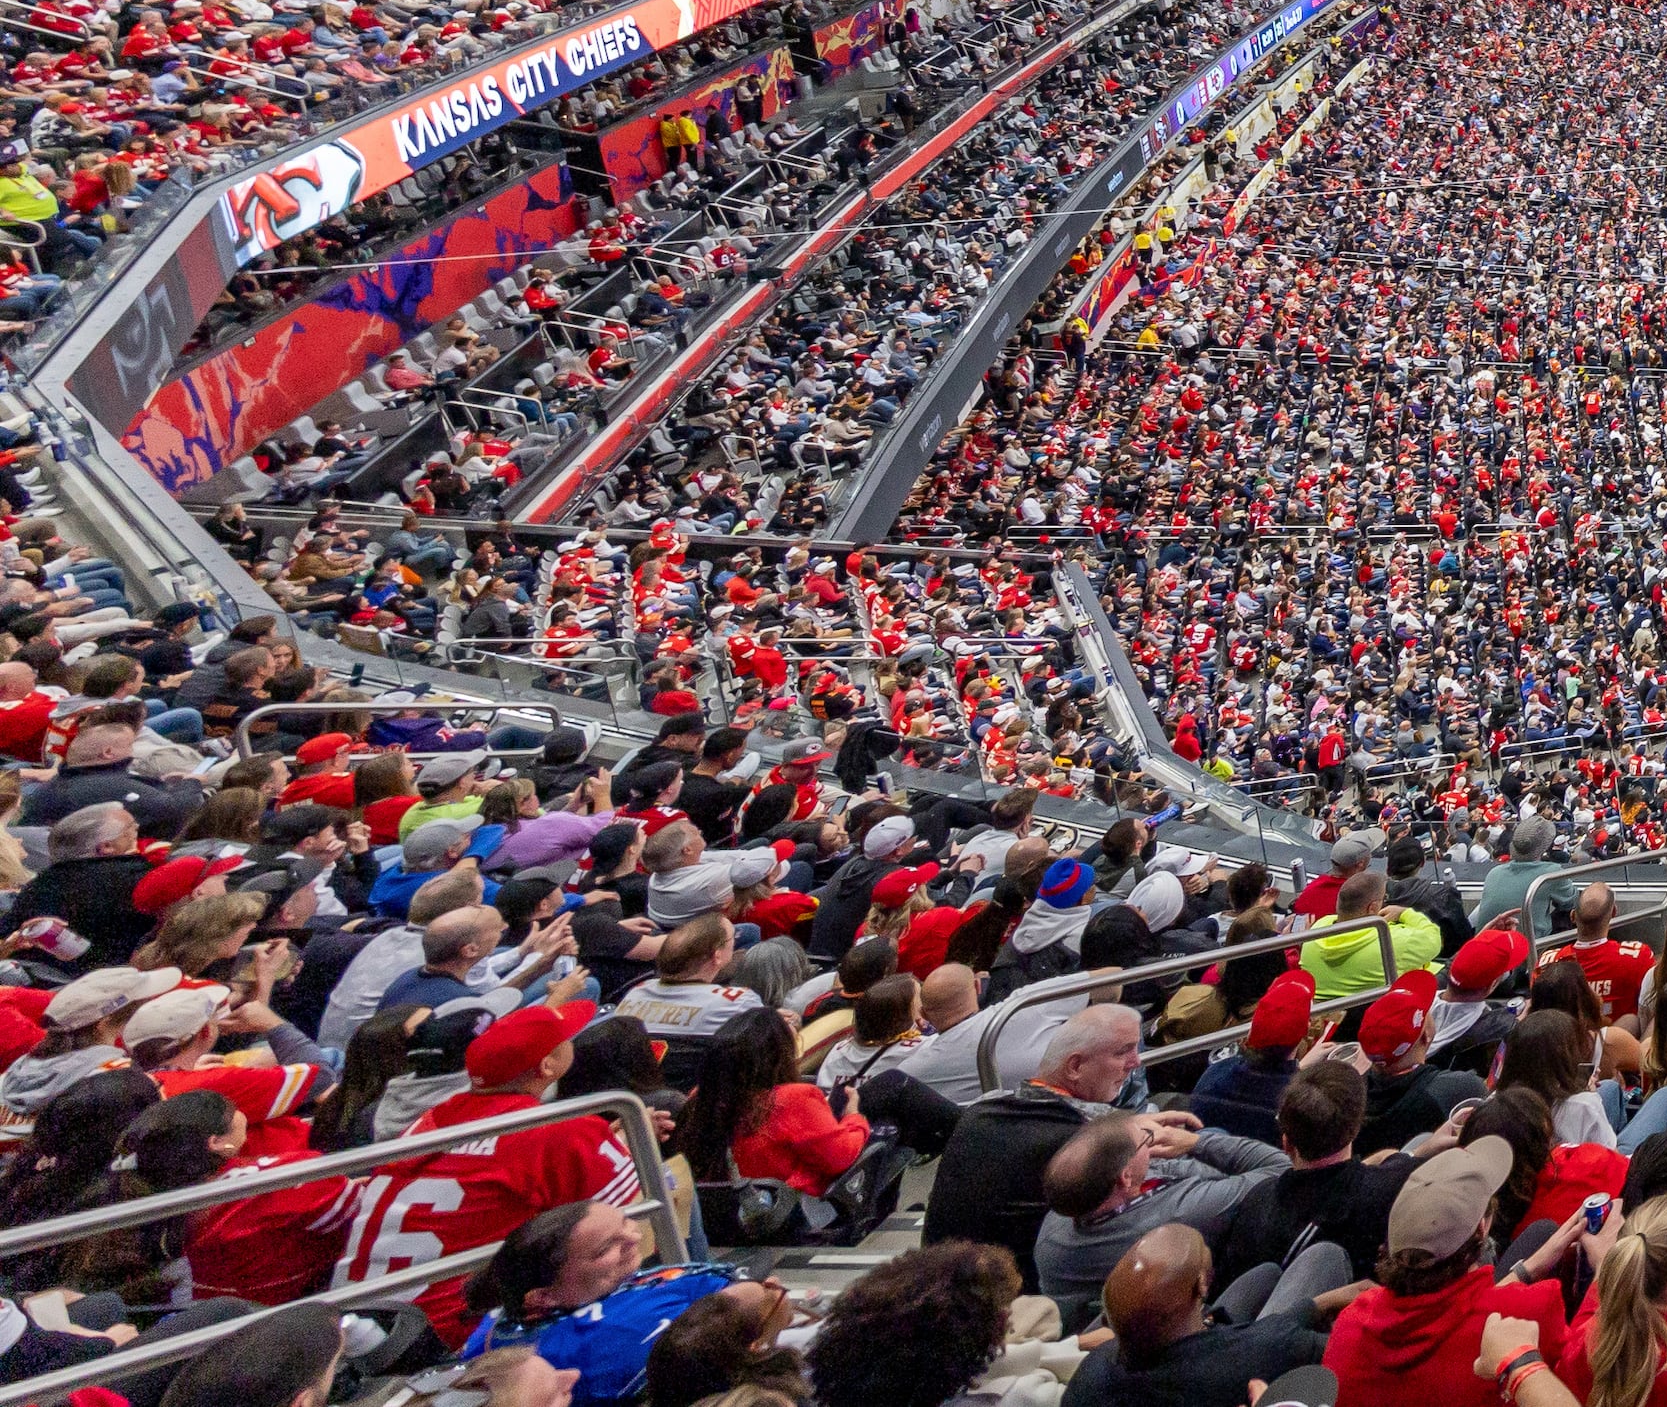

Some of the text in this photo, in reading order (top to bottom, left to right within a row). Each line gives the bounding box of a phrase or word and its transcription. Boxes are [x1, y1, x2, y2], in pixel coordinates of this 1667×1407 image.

[391, 14, 643, 164] KANSAS CITY CHIEFS
